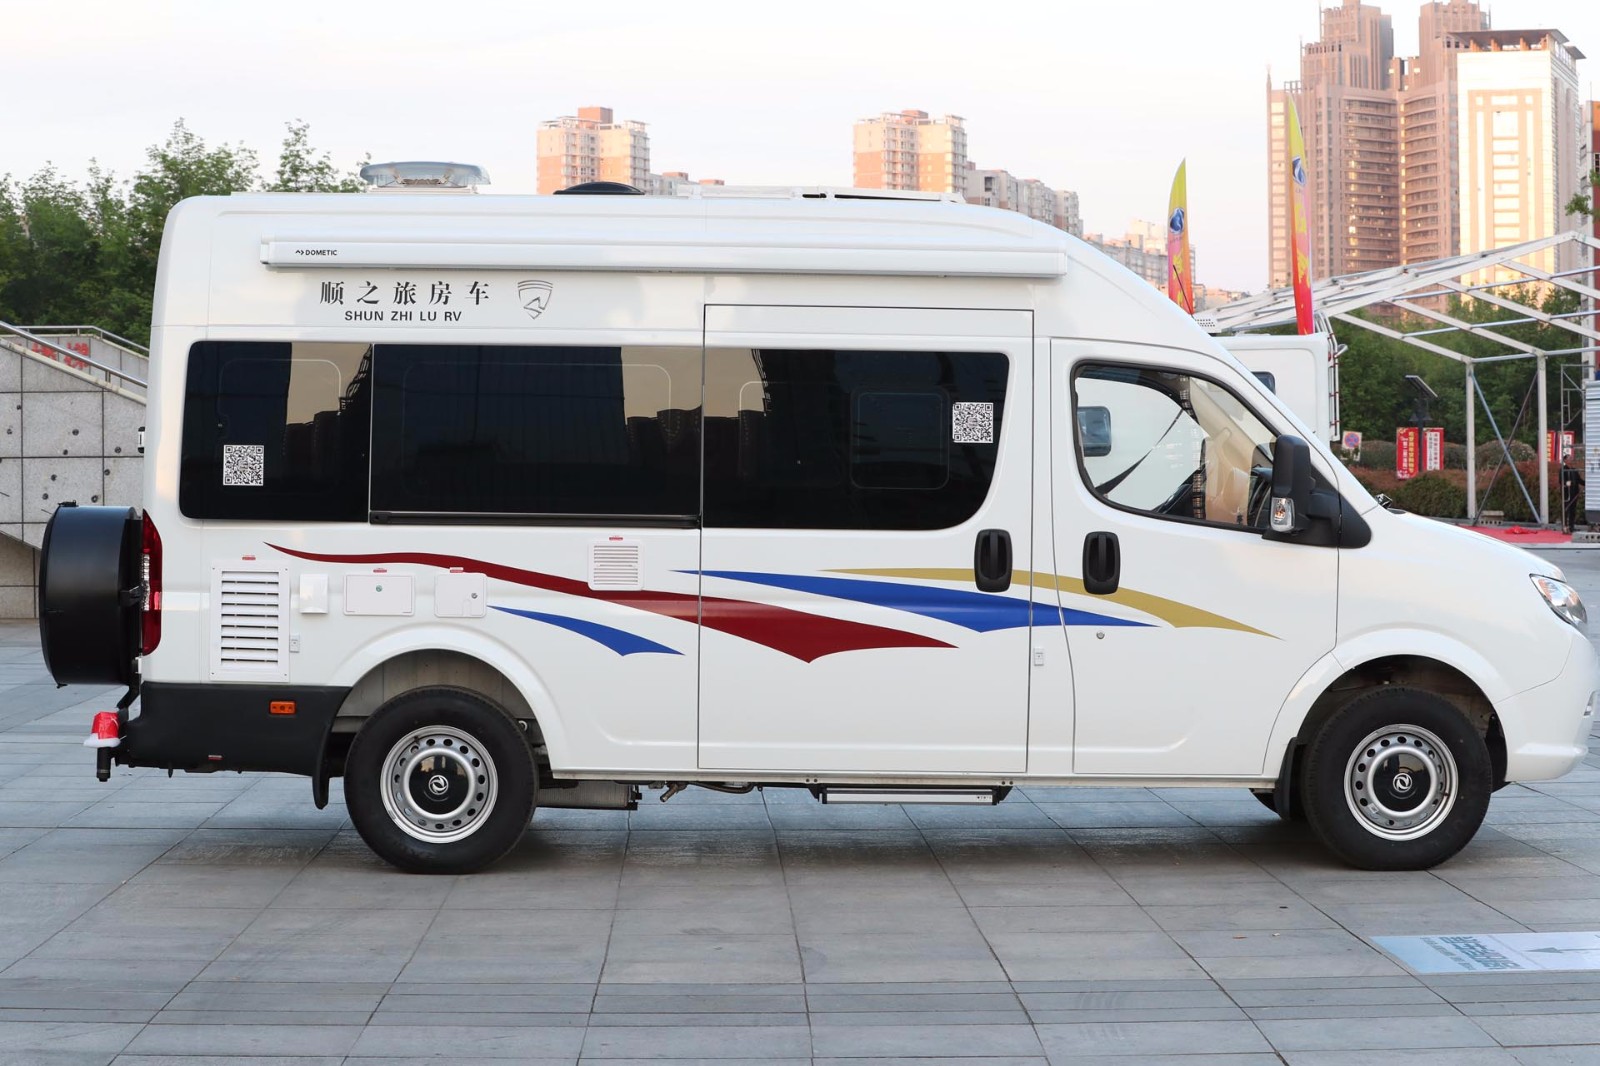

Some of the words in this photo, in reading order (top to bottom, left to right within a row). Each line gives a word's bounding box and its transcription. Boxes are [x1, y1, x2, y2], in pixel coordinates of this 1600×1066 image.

[319, 280, 490, 306] 顺之旅房车
[344, 310, 384, 322] SHUN
[390, 310, 413, 322] ZHI
[419, 310, 437, 322] LU
[444, 310, 462, 322] RV
